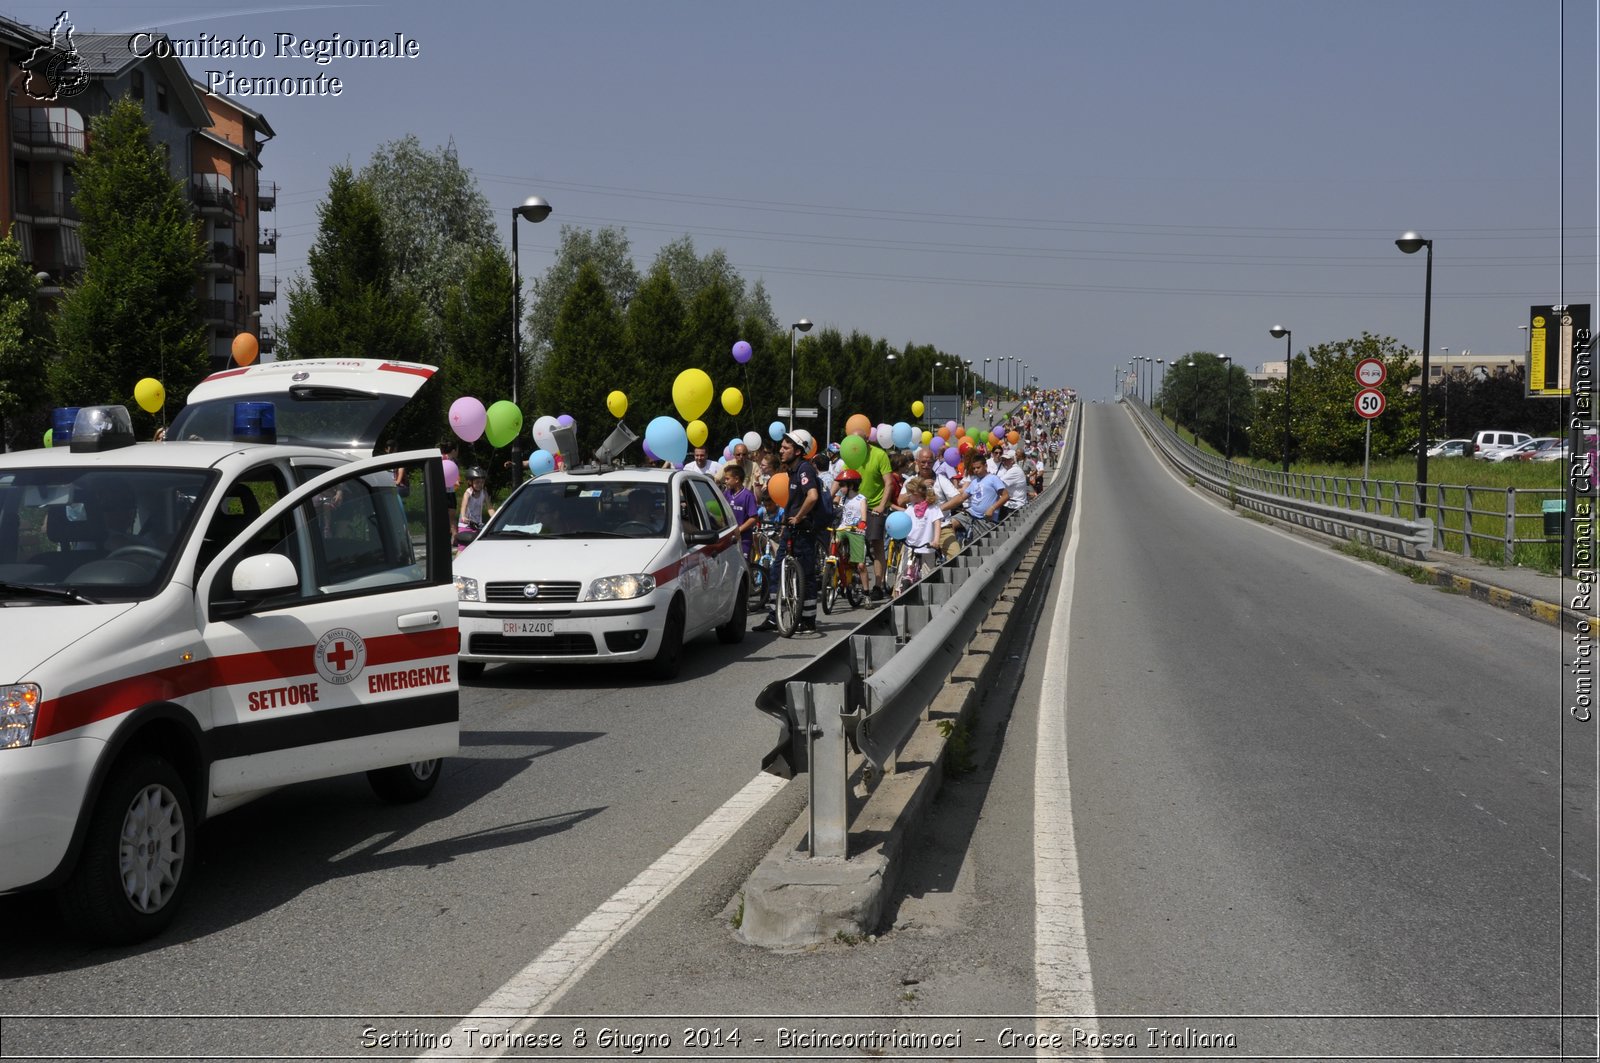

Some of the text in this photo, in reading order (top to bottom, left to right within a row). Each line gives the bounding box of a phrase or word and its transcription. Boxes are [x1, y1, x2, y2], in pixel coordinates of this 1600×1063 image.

[1362, 396, 1378, 410] 50
[368, 664, 451, 694] EMERGENZE
[248, 682, 319, 712] SETTORE
